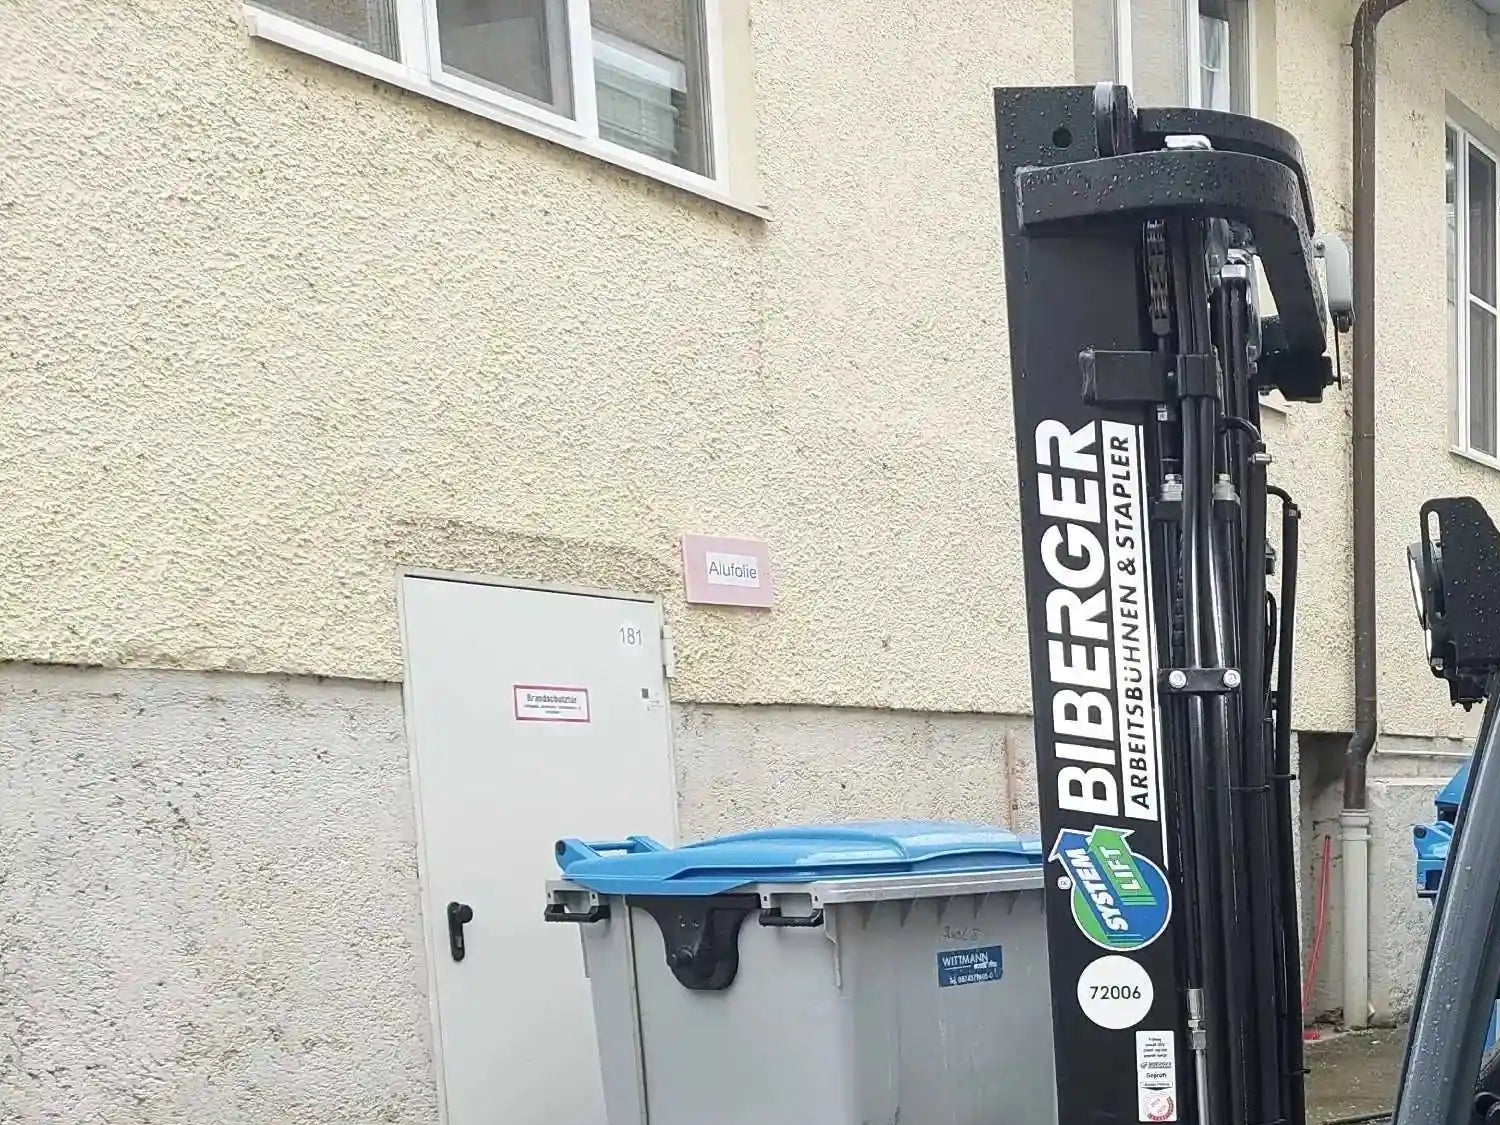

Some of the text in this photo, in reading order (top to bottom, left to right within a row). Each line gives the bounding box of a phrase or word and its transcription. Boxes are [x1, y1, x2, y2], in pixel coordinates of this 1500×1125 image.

[709, 561, 757, 579] Alufolie
[1035, 419, 1119, 816] BIBERGER
[1109, 436, 1150, 810] ARBEITSBÜHNEN & STAPLER
[619, 627, 642, 645] 181
[1097, 845, 1142, 890] LIFT
[1064, 848, 1129, 931] SYSTEM
[942, 952, 988, 967] WITTMANN
[1090, 985, 1142, 1000] 72006
